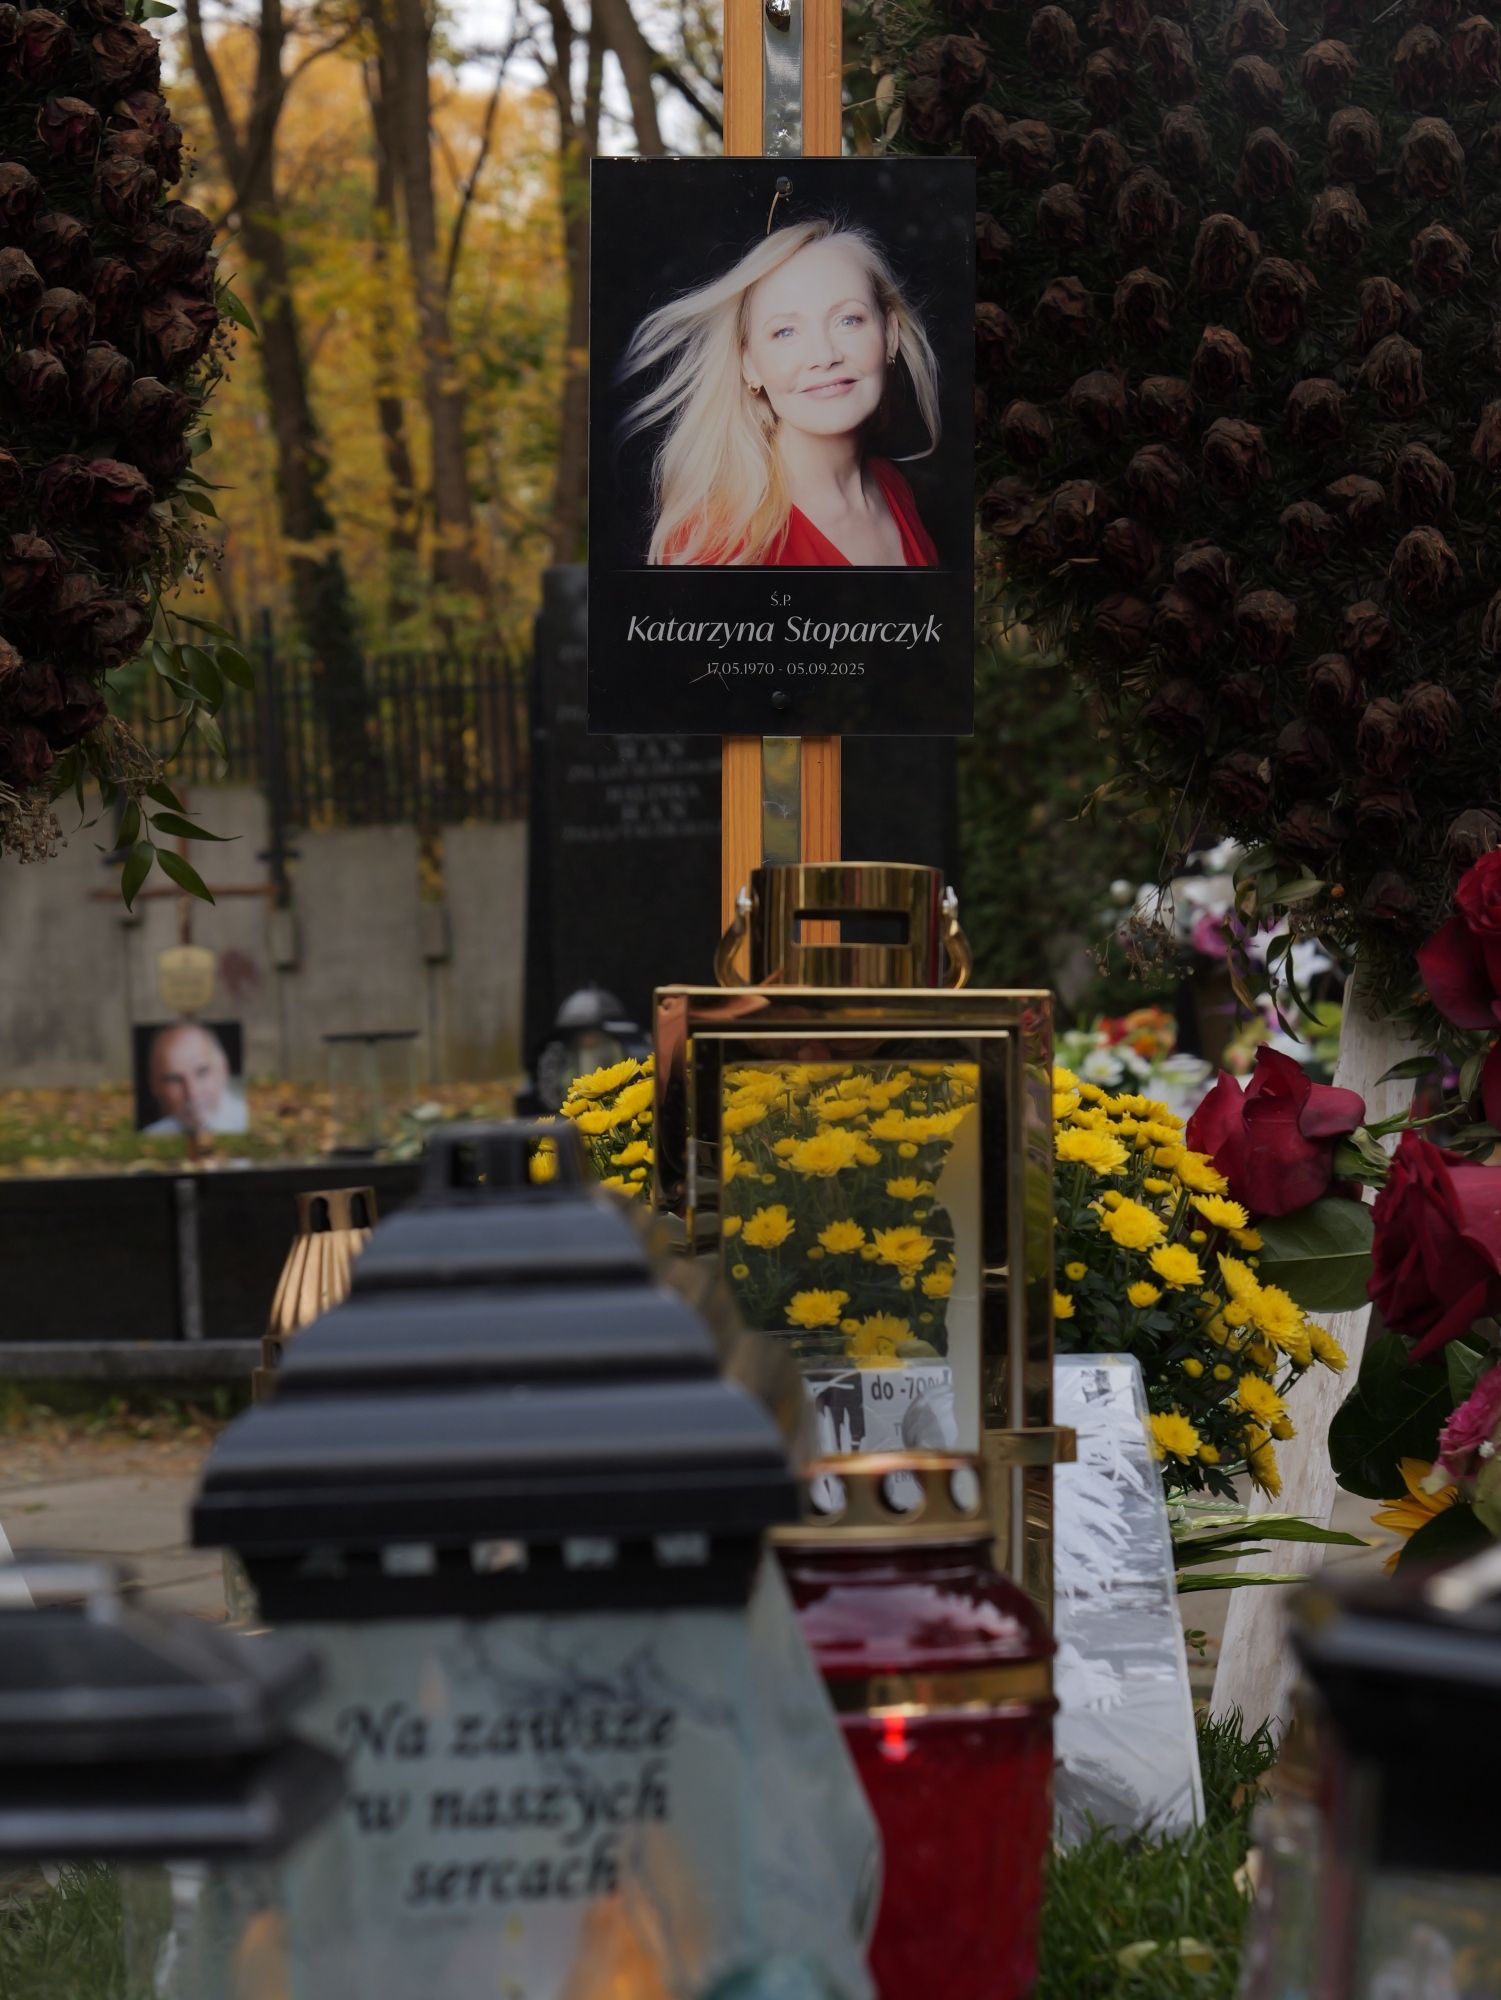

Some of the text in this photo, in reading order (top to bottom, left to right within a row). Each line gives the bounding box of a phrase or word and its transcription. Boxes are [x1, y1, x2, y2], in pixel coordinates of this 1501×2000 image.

[626, 614, 942, 649] Katarzyna Stoparczyk
[707, 662, 774, 676] 17.05.1970
[787, 662, 865, 675] 05.09.2025
[871, 1374, 894, 1401] do
[335, 1699, 678, 1761] Na zawsze
[349, 1757, 671, 1847] w naszych
[407, 1832, 619, 1904] sercach
